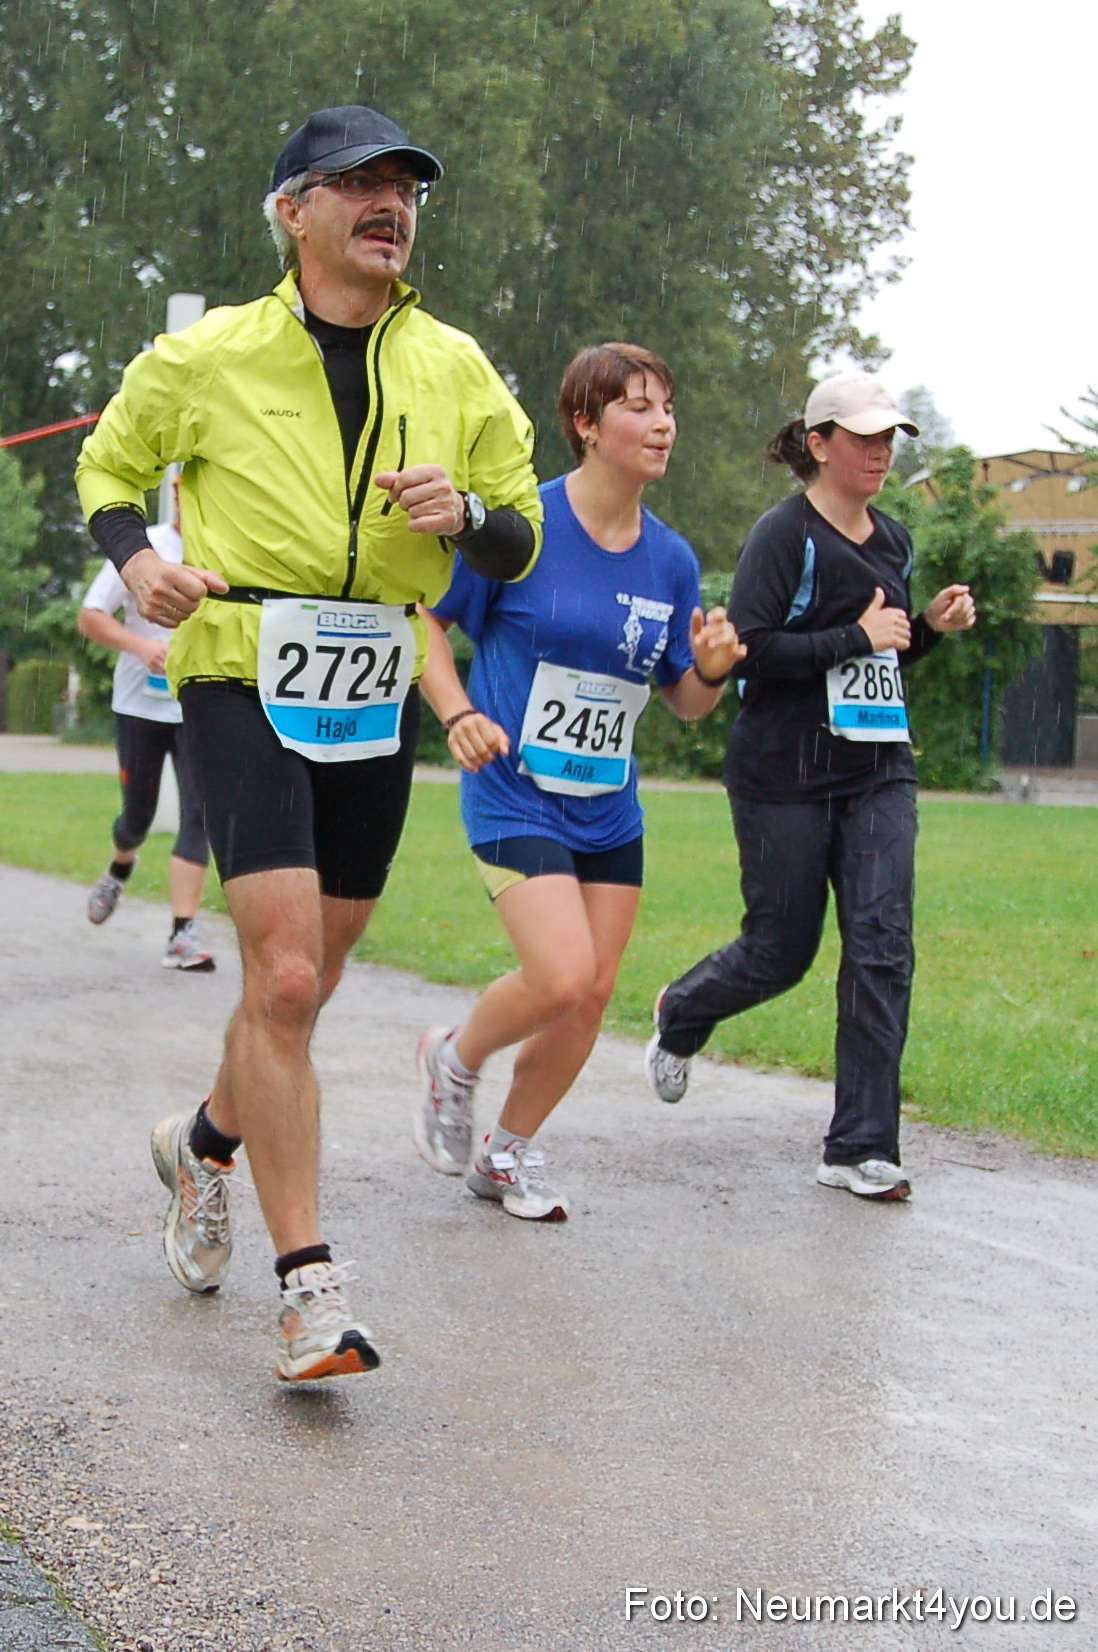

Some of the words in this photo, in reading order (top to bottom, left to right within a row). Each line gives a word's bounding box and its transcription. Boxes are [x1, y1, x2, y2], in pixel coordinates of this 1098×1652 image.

[317, 612, 379, 628] BOCK
[275, 642, 402, 701] 2724
[316, 715, 357, 742] Hajo
[537, 699, 626, 752] 2454
[561, 759, 595, 782] Anja
